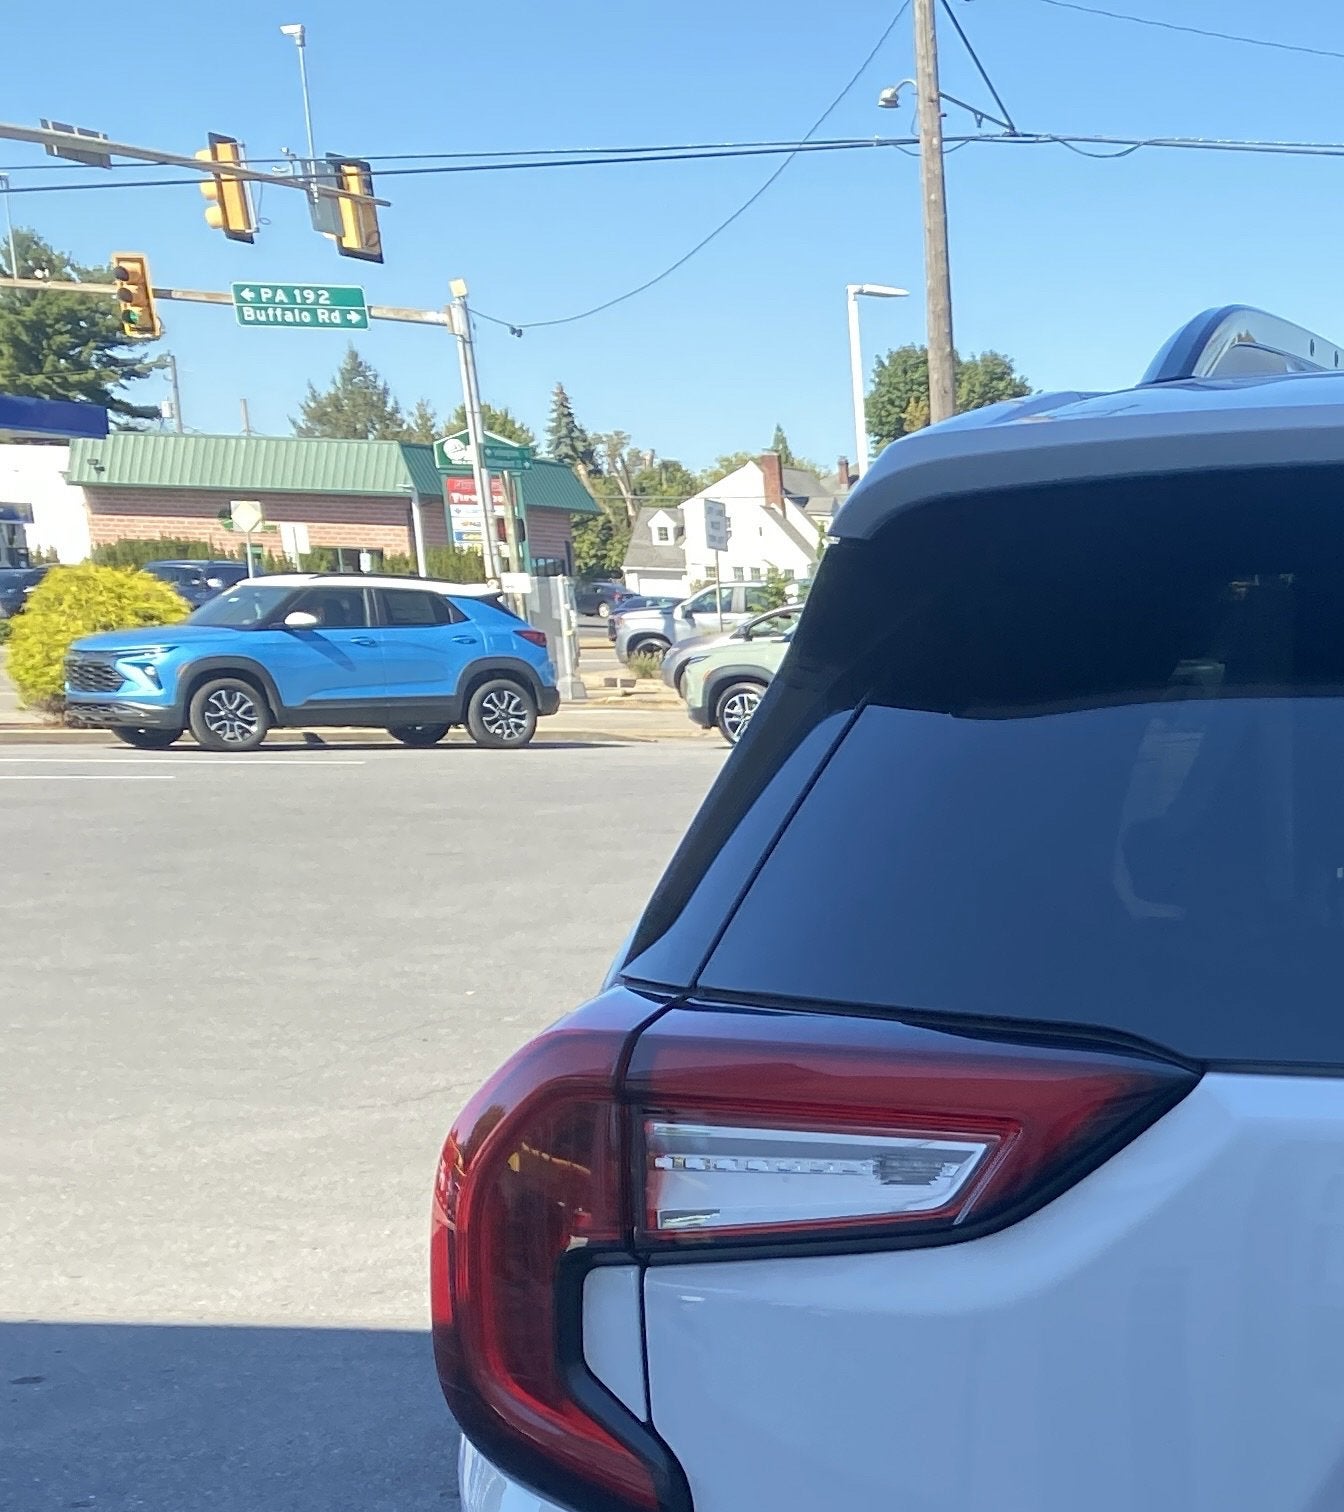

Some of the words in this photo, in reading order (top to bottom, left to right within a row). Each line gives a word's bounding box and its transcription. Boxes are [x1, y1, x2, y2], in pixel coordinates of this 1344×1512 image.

[260, 287, 288, 303] PA
[293, 288, 330, 305] 192
[242, 306, 311, 323] Buffalo
[317, 308, 341, 324] Rd
